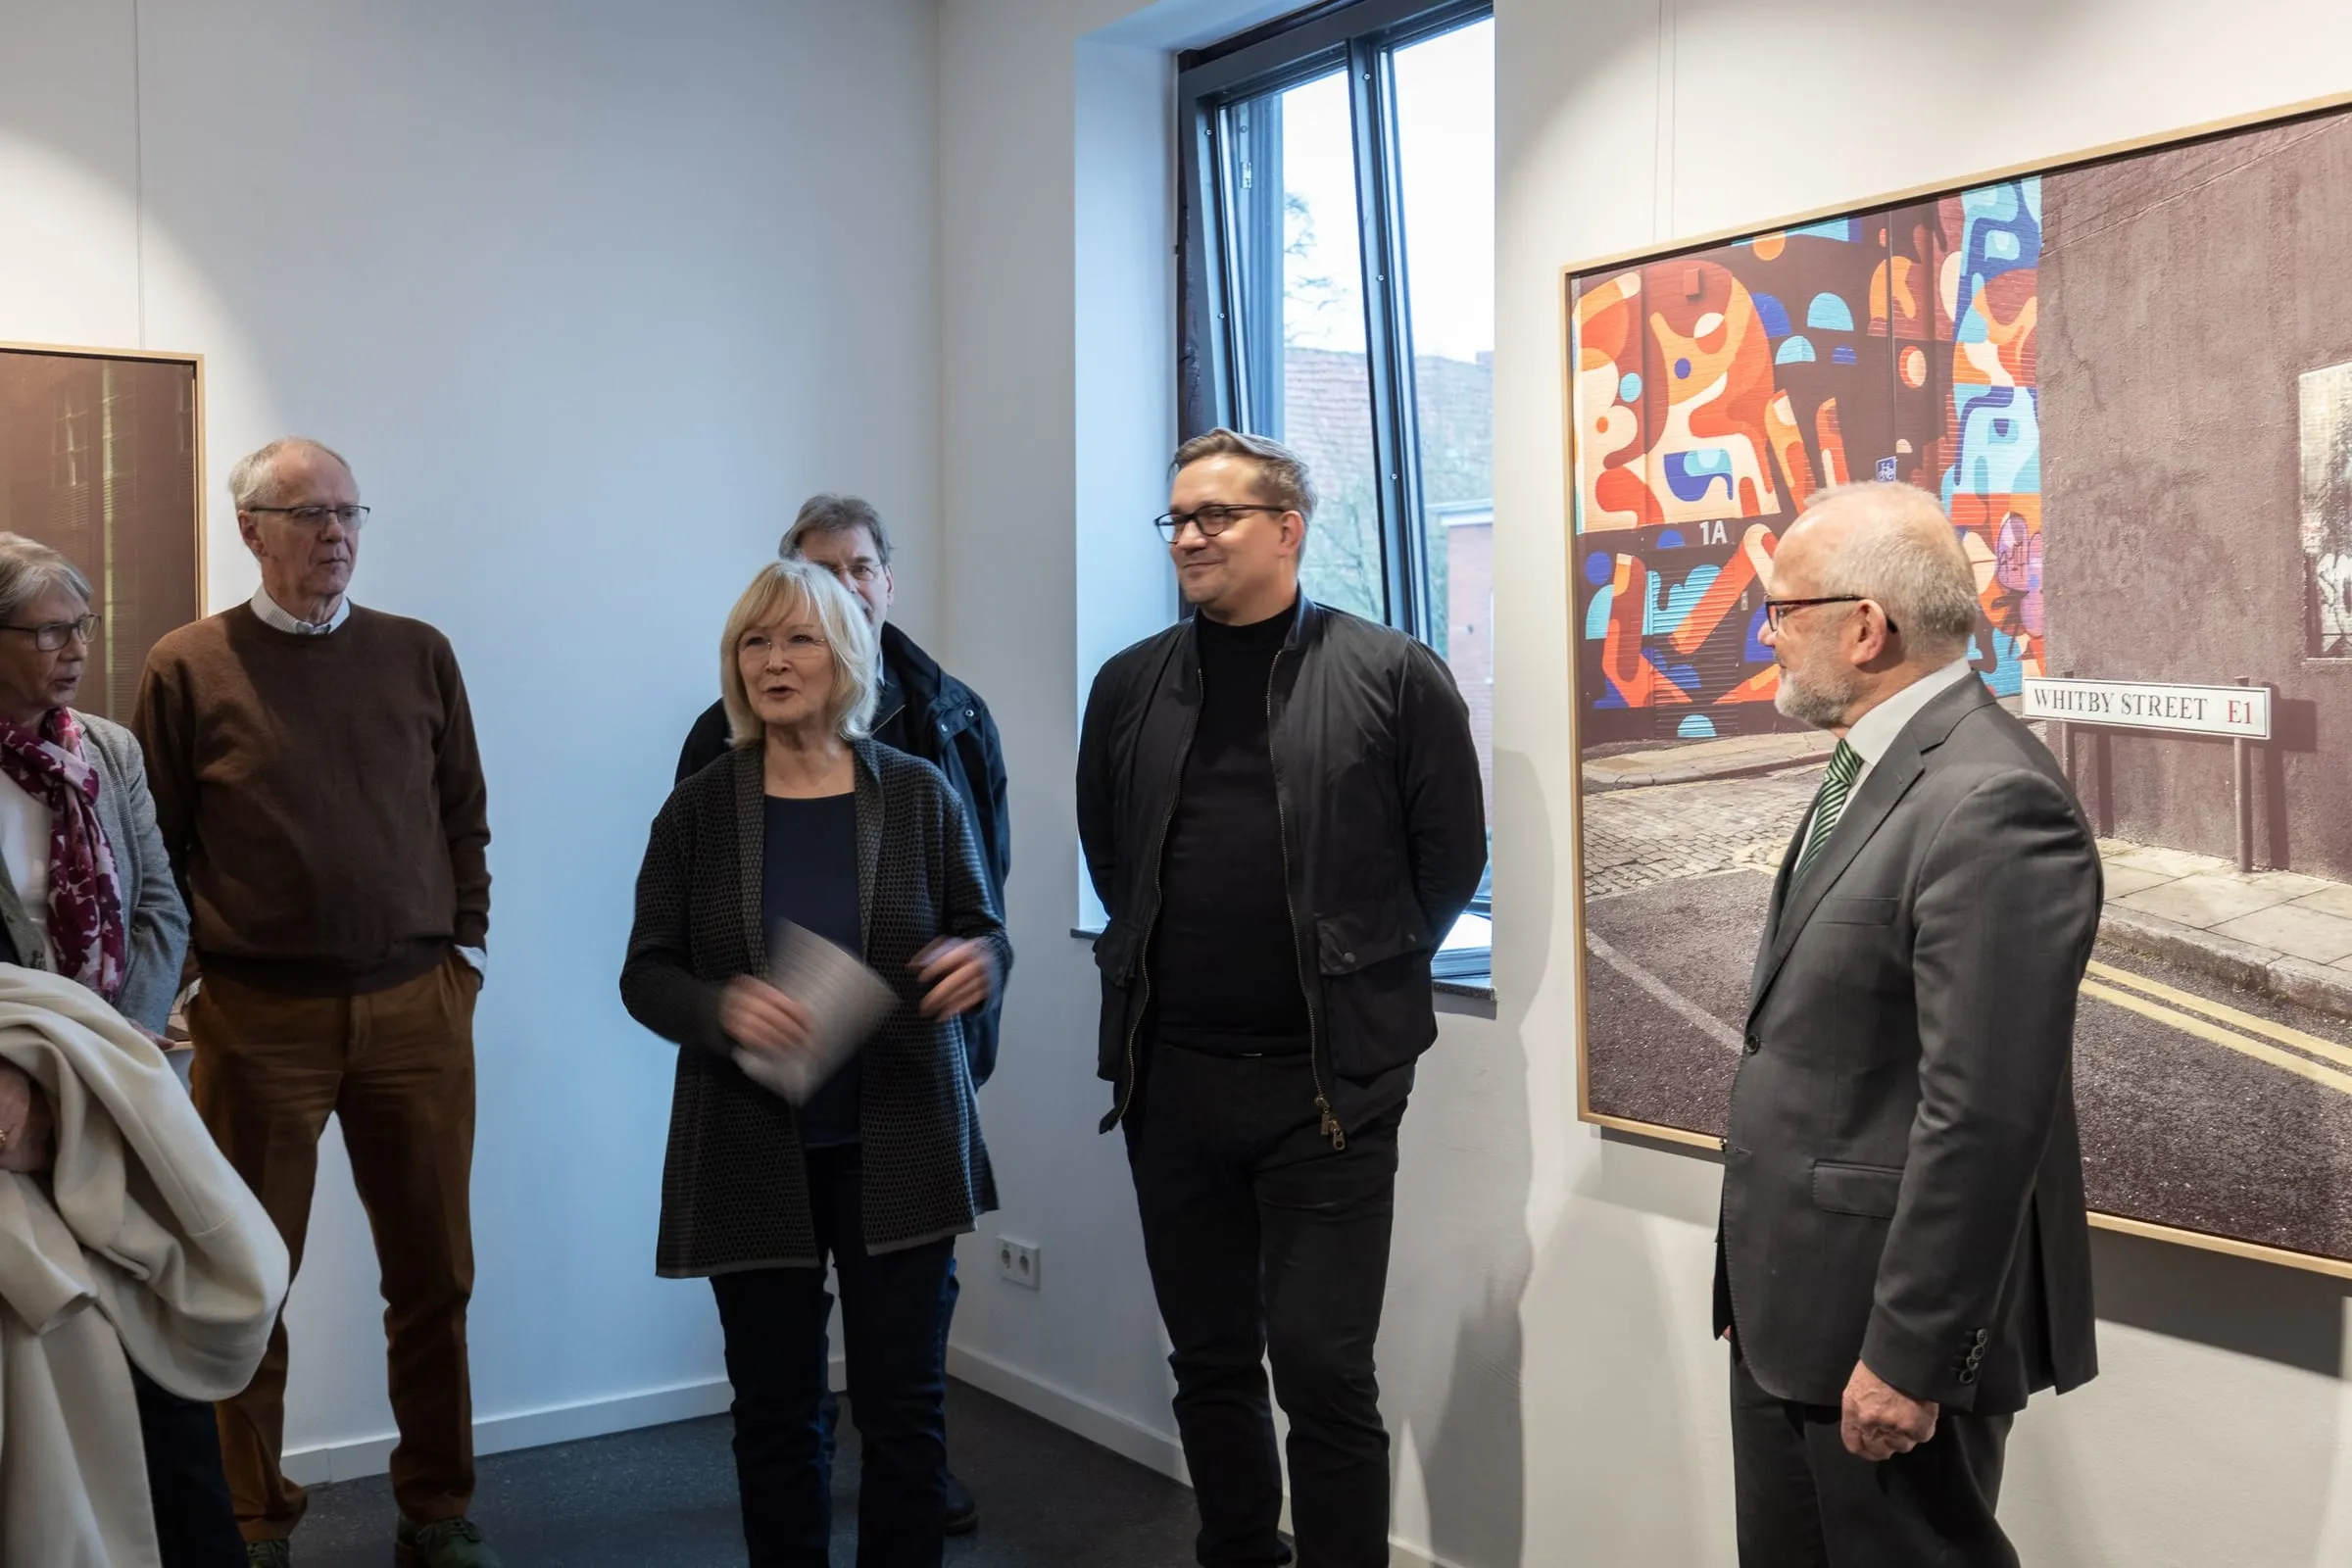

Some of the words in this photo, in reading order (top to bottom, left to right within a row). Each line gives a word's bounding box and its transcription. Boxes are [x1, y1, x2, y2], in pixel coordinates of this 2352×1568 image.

[1699, 519, 1729, 546] 1A
[2034, 687, 2115, 713] WHITBY
[2121, 692, 2209, 720] STREET
[2228, 699, 2253, 725] E1
